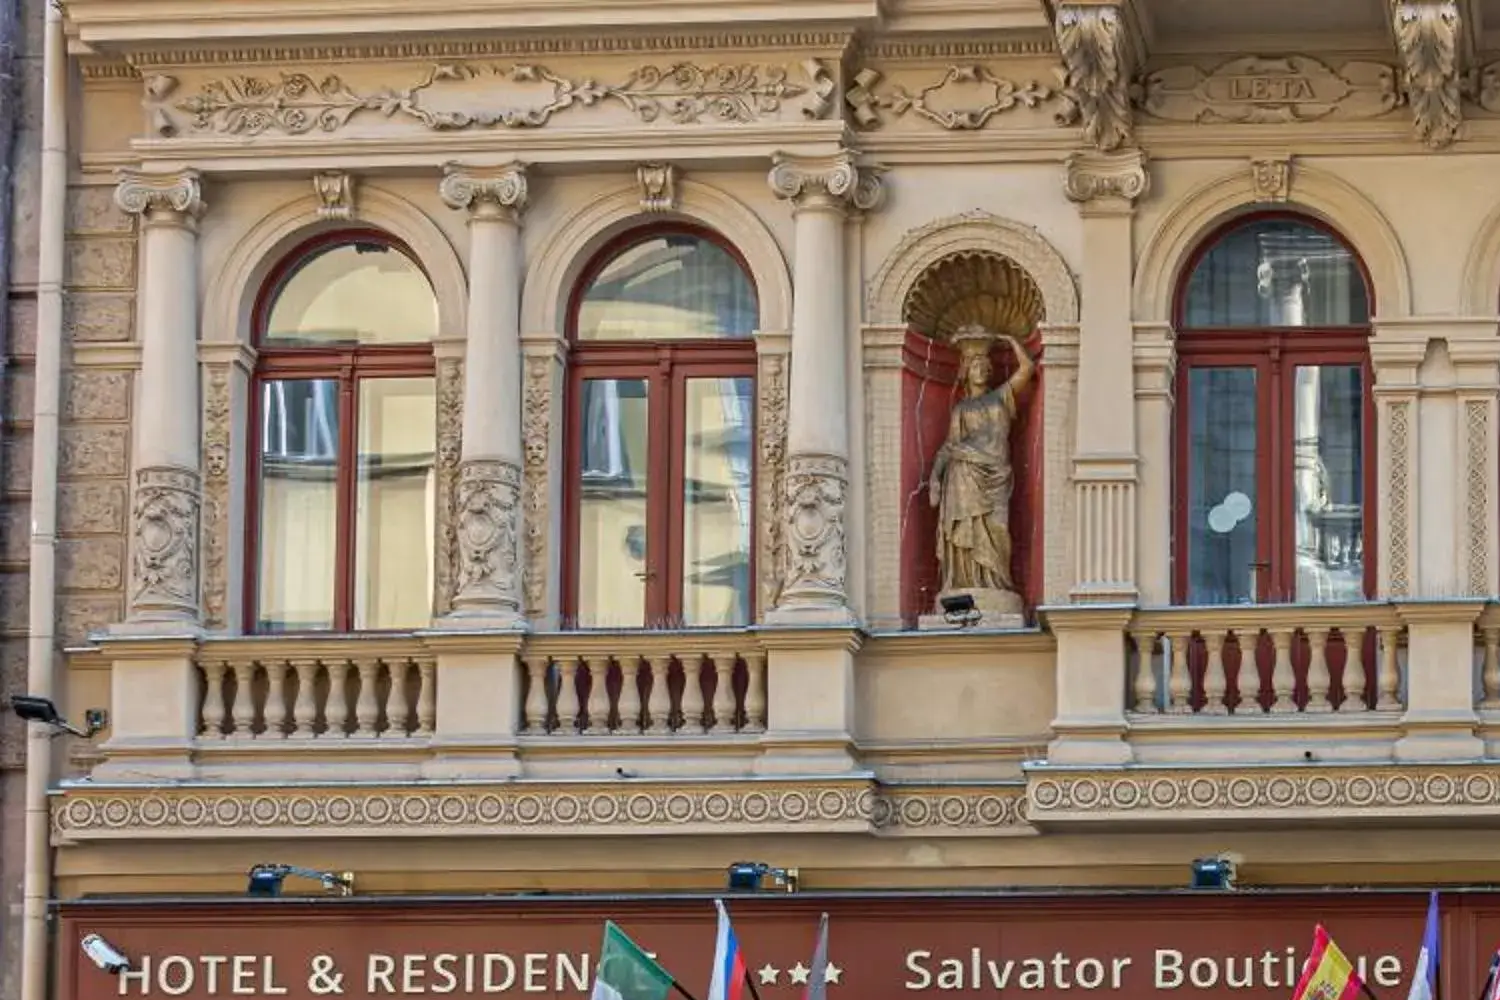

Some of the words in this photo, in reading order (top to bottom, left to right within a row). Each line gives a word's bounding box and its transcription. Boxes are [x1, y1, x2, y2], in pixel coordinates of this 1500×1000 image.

[118, 954, 287, 995] HOTEL
[307, 954, 344, 995] &
[366, 953, 657, 994] RESIDEN
[905, 947, 1132, 989] Salvator
